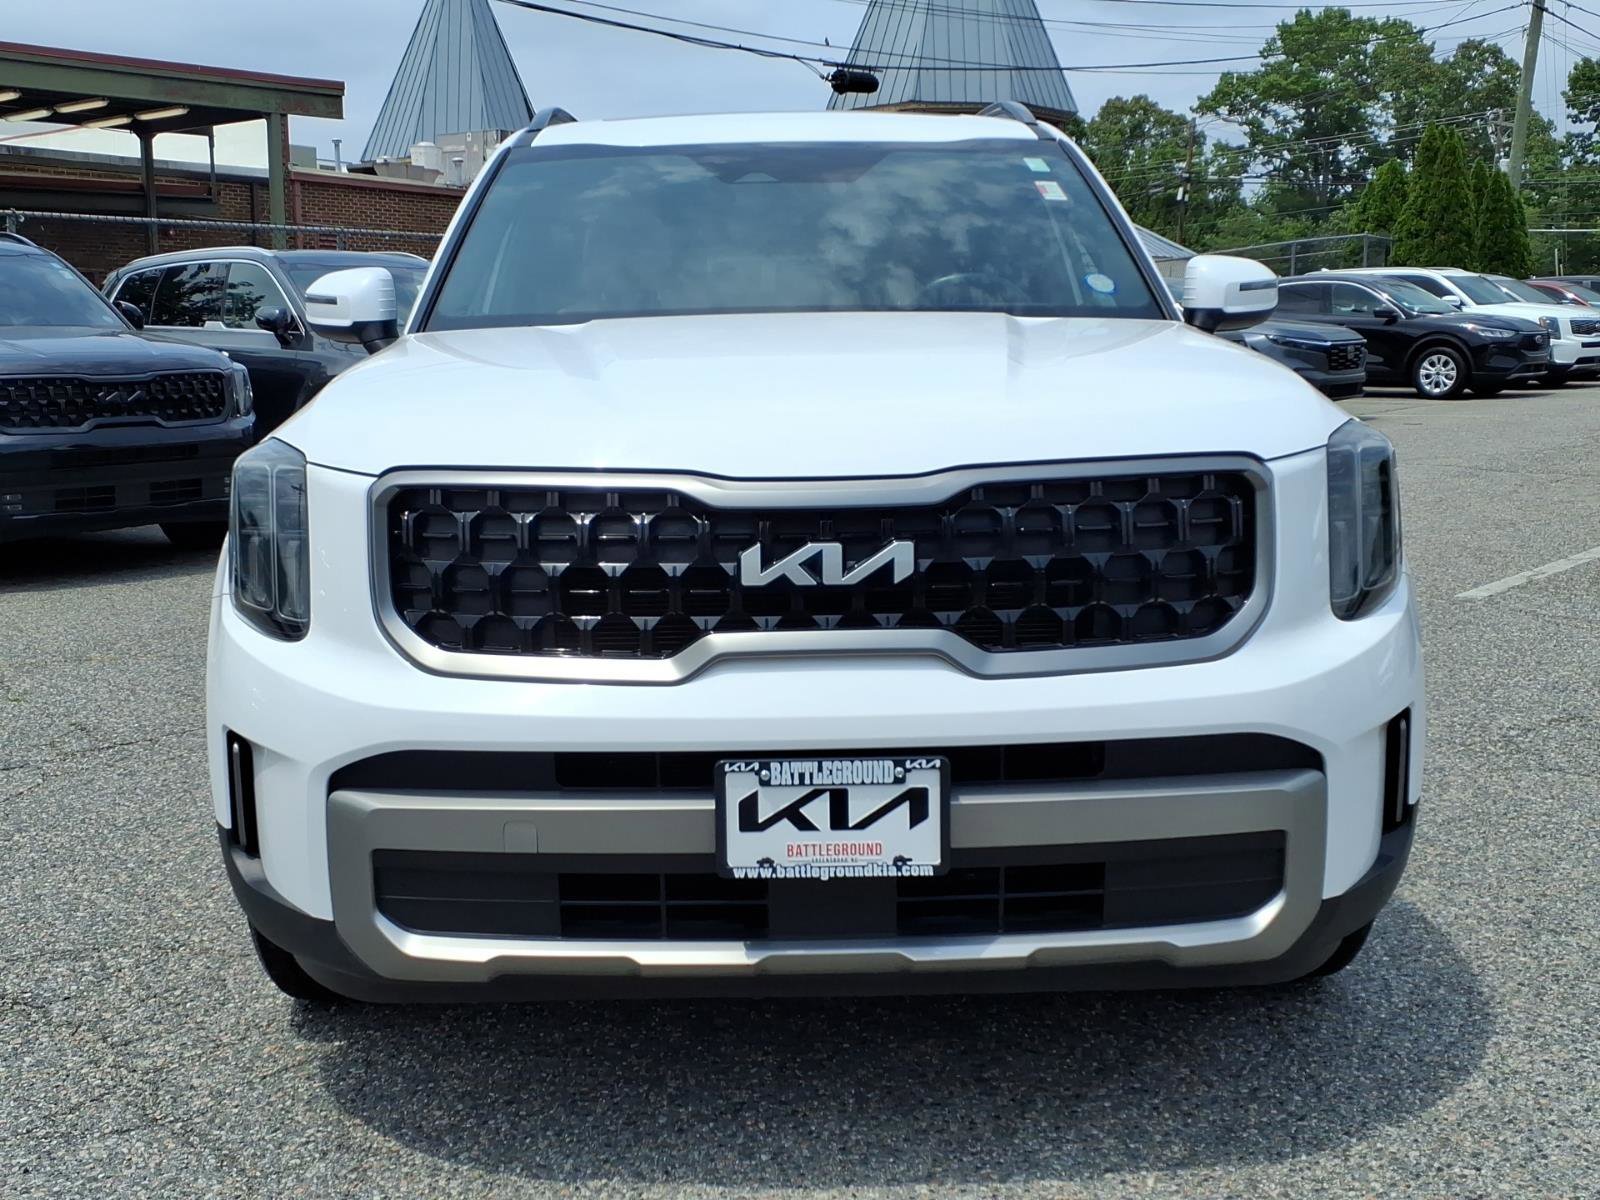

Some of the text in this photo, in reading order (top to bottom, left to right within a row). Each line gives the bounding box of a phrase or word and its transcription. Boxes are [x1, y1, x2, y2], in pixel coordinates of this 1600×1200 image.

[741, 541, 914, 586] KIA
[725, 760, 759, 772] KIA
[770, 760, 895, 785] BATTLEGROUND
[906, 759, 941, 769] KIA
[739, 787, 929, 832] KIA
[787, 843, 882, 857] BATTLEGROUND
[734, 863, 934, 880] www.battlegroundkia.com
